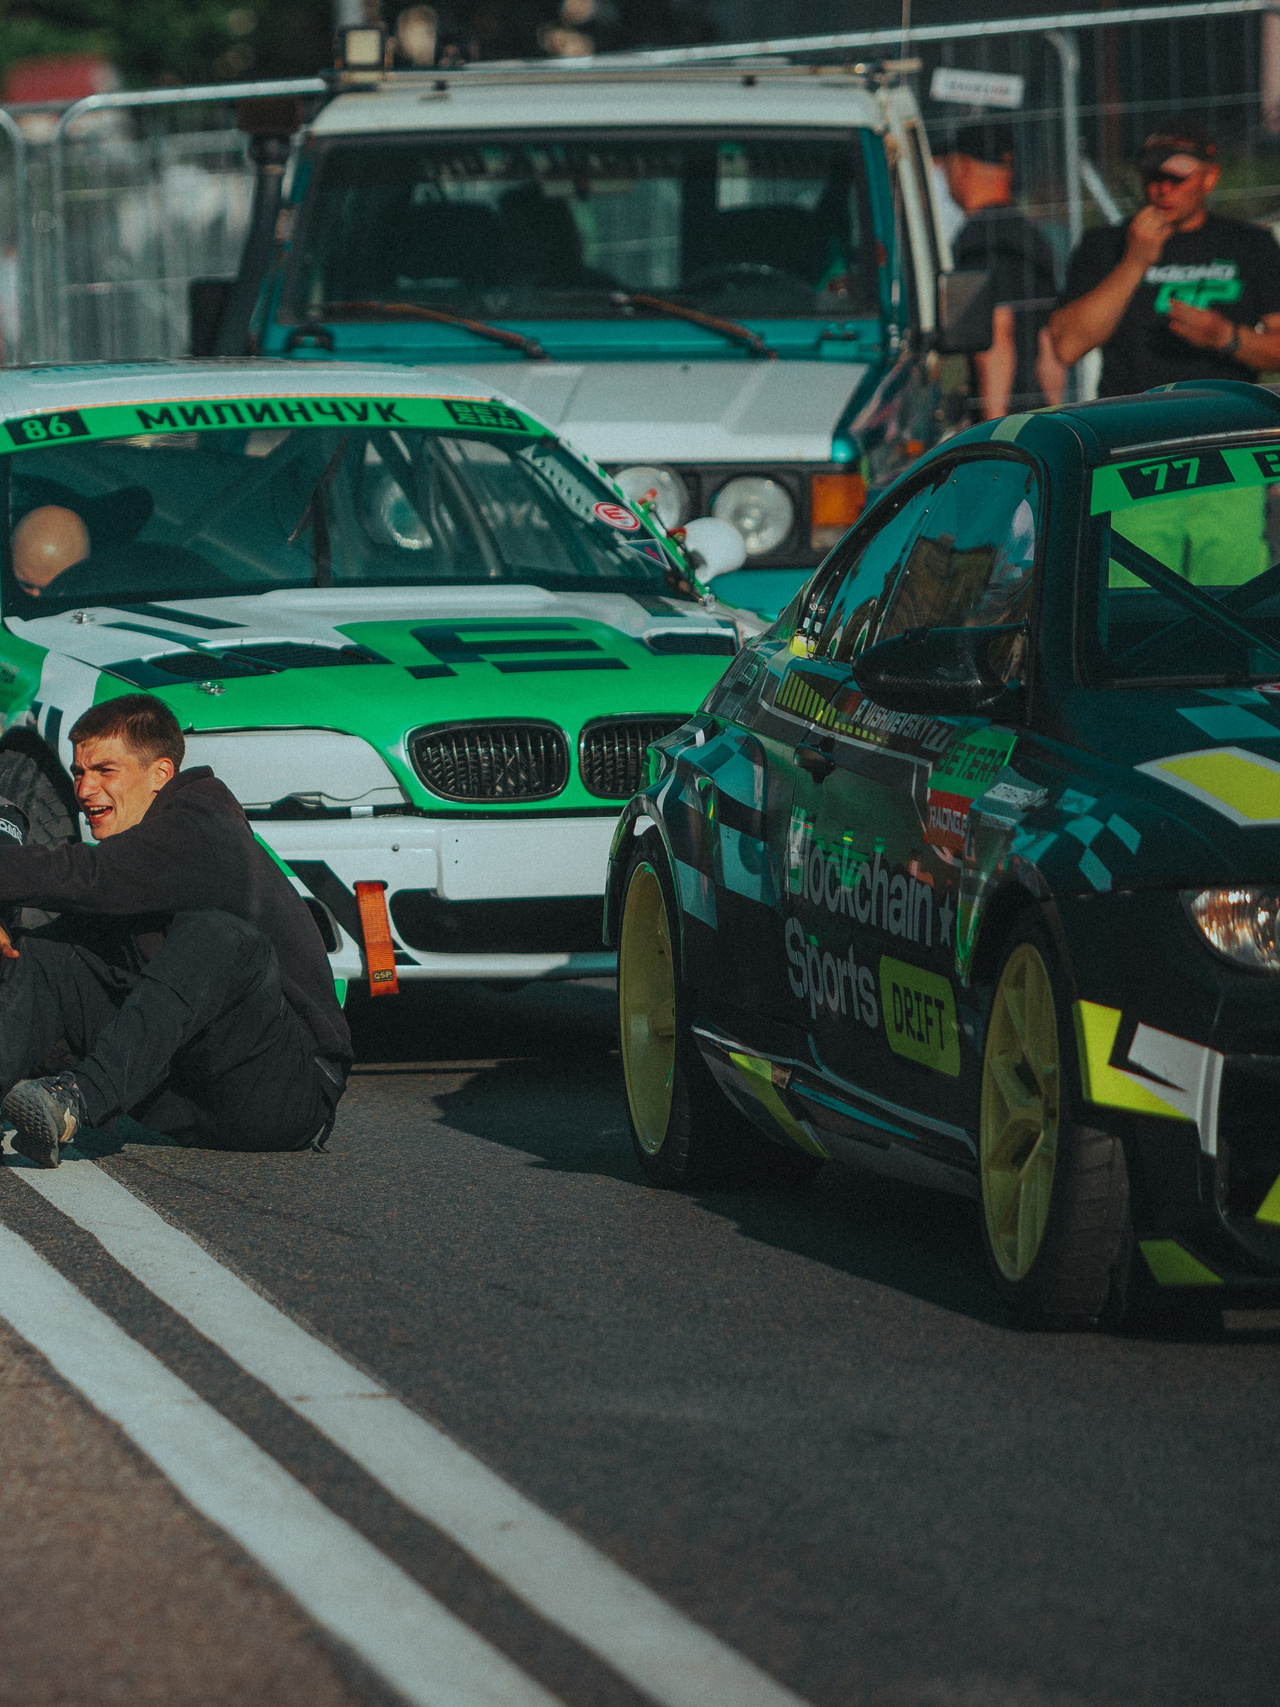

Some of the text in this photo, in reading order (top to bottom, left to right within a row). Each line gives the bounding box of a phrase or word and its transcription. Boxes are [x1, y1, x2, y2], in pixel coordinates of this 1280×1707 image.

[21, 415, 72, 441] 86
[135, 400, 408, 430] МИЛИНЧУК
[1140, 457, 1200, 491] 77
[373, 971, 393, 980] QSP
[785, 917, 878, 1028] Sports
[891, 981, 945, 1051] DRIFT
